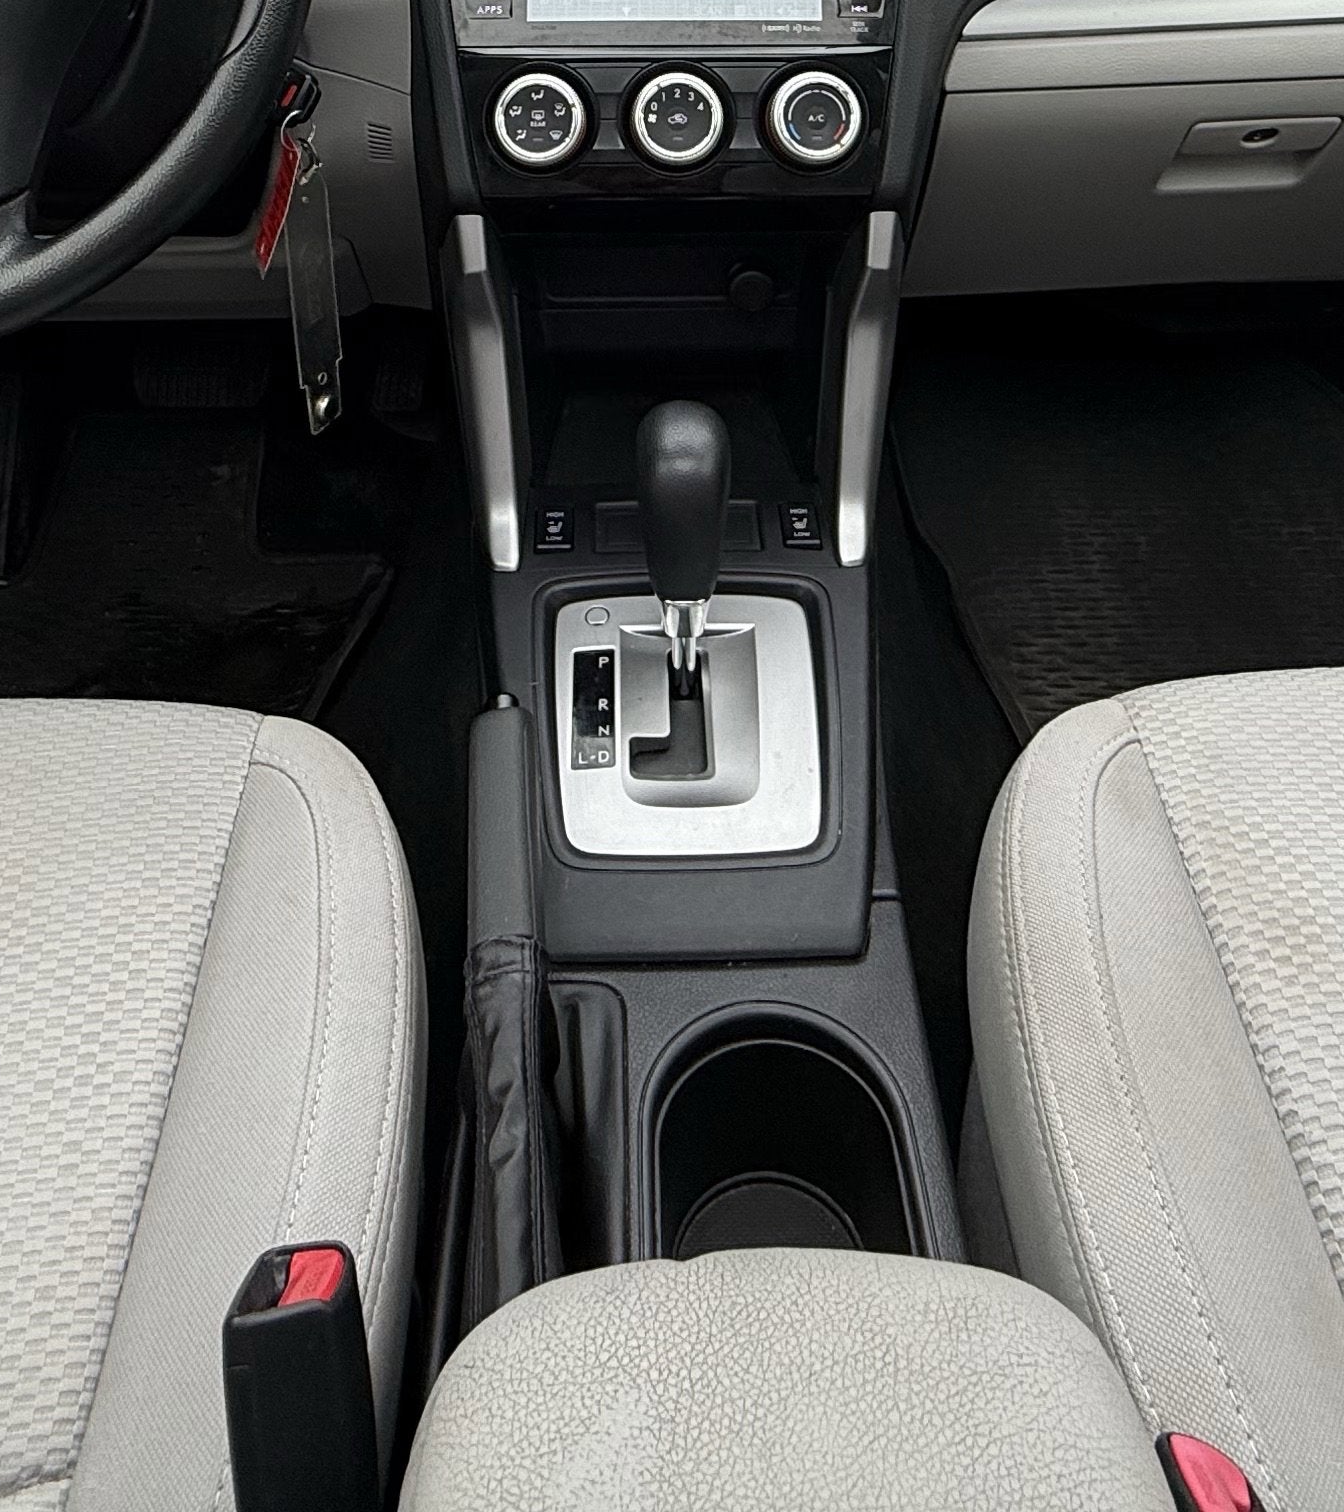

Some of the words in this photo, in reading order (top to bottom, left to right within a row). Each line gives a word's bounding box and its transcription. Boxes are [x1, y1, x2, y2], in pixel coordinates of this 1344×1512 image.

[476, 5, 504, 15] APPS
[661, 91, 666, 102] 1
[673, 87, 681, 98] 2
[687, 91, 695, 101] 3
[650, 101, 658, 111] 0
[696, 101, 705, 111] 4
[807, 114, 825, 122] A/C
[598, 656, 610, 668] P
[598, 698, 609, 711] R
[598, 724, 610, 736] N
